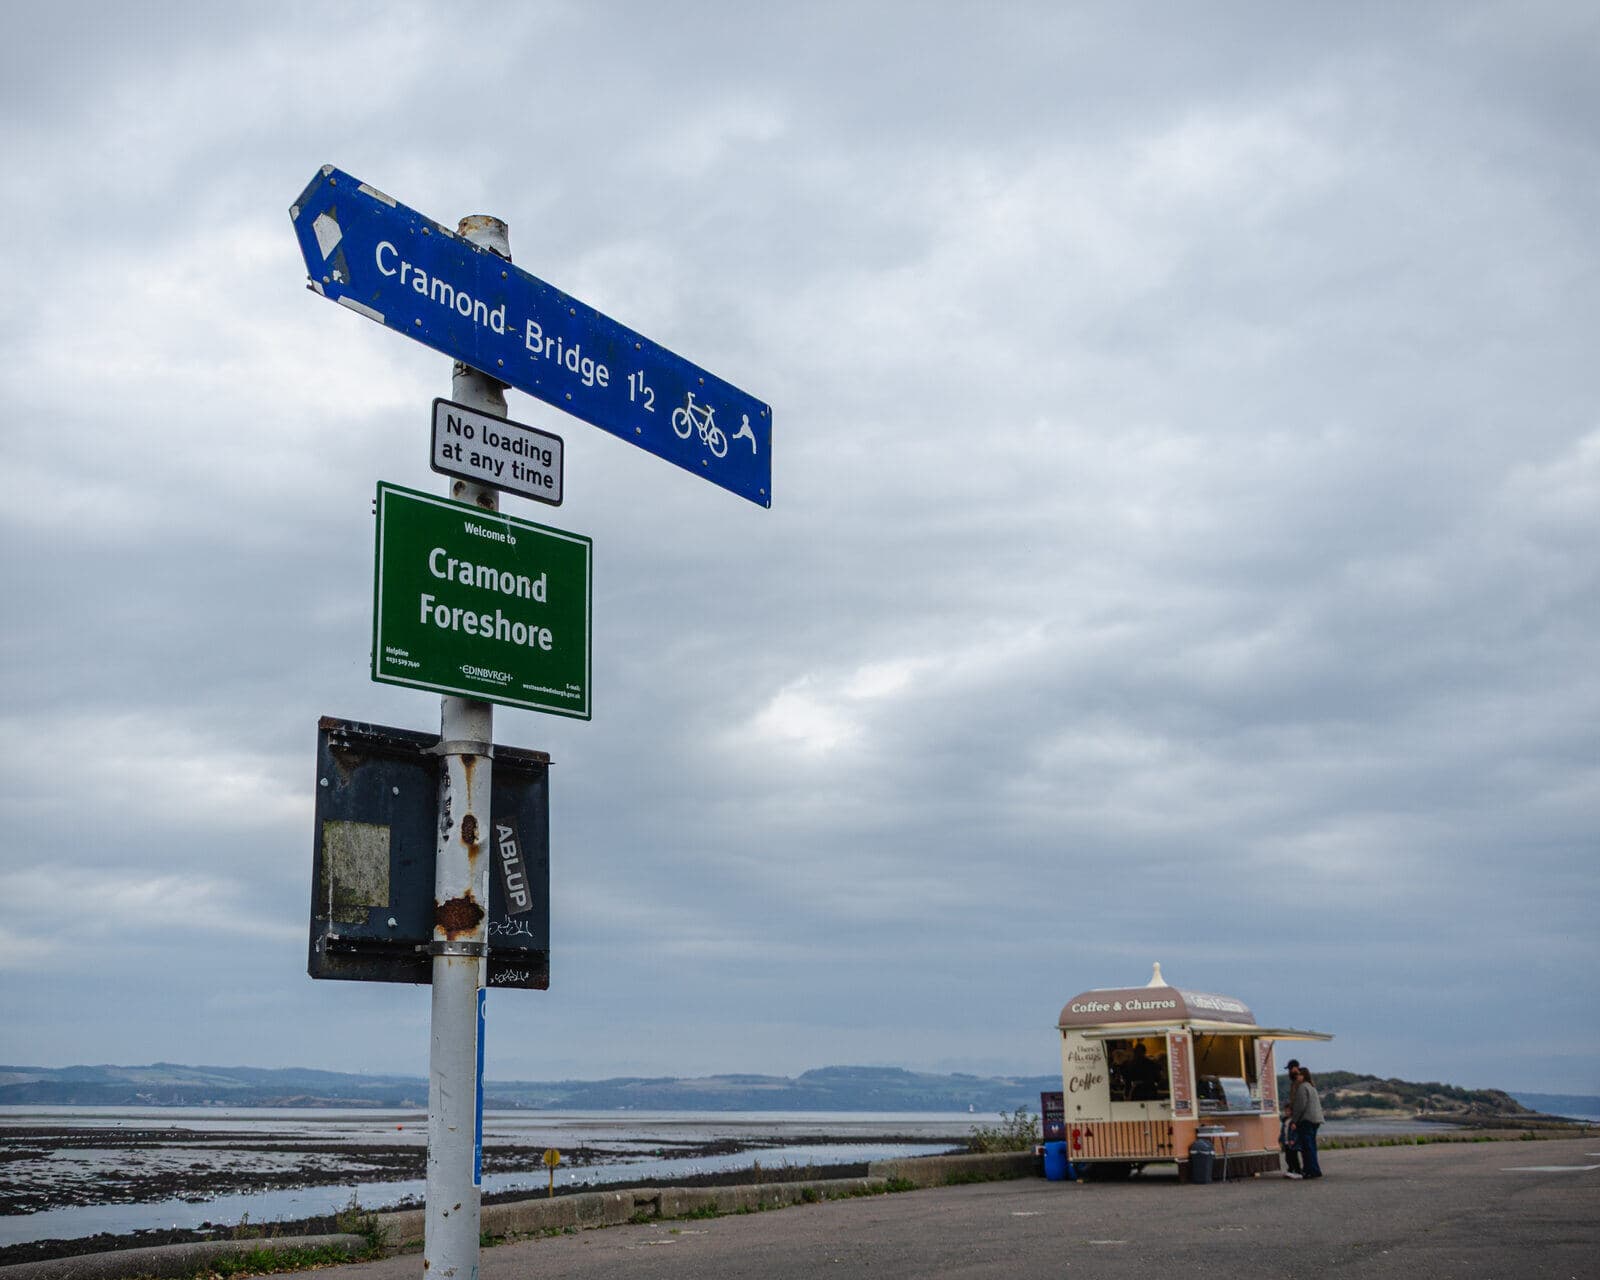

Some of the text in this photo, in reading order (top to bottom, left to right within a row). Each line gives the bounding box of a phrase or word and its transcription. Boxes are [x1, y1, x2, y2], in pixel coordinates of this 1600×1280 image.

[375, 241, 506, 335] Cramond
[526, 319, 609, 387] Bridge
[442, 443, 554, 489] at any time
[446, 414, 552, 467] No loading
[464, 521, 516, 545] Welcome to
[429, 547, 547, 603] Cramond
[420, 593, 553, 651] Foreshore
[496, 824, 527, 907] ABLUP
[1071, 1001, 1110, 1013] Coffee
[1112, 1001, 1123, 1012] &
[1125, 999, 1176, 1011] Churros
[1069, 1072, 1104, 1093] Coffee
